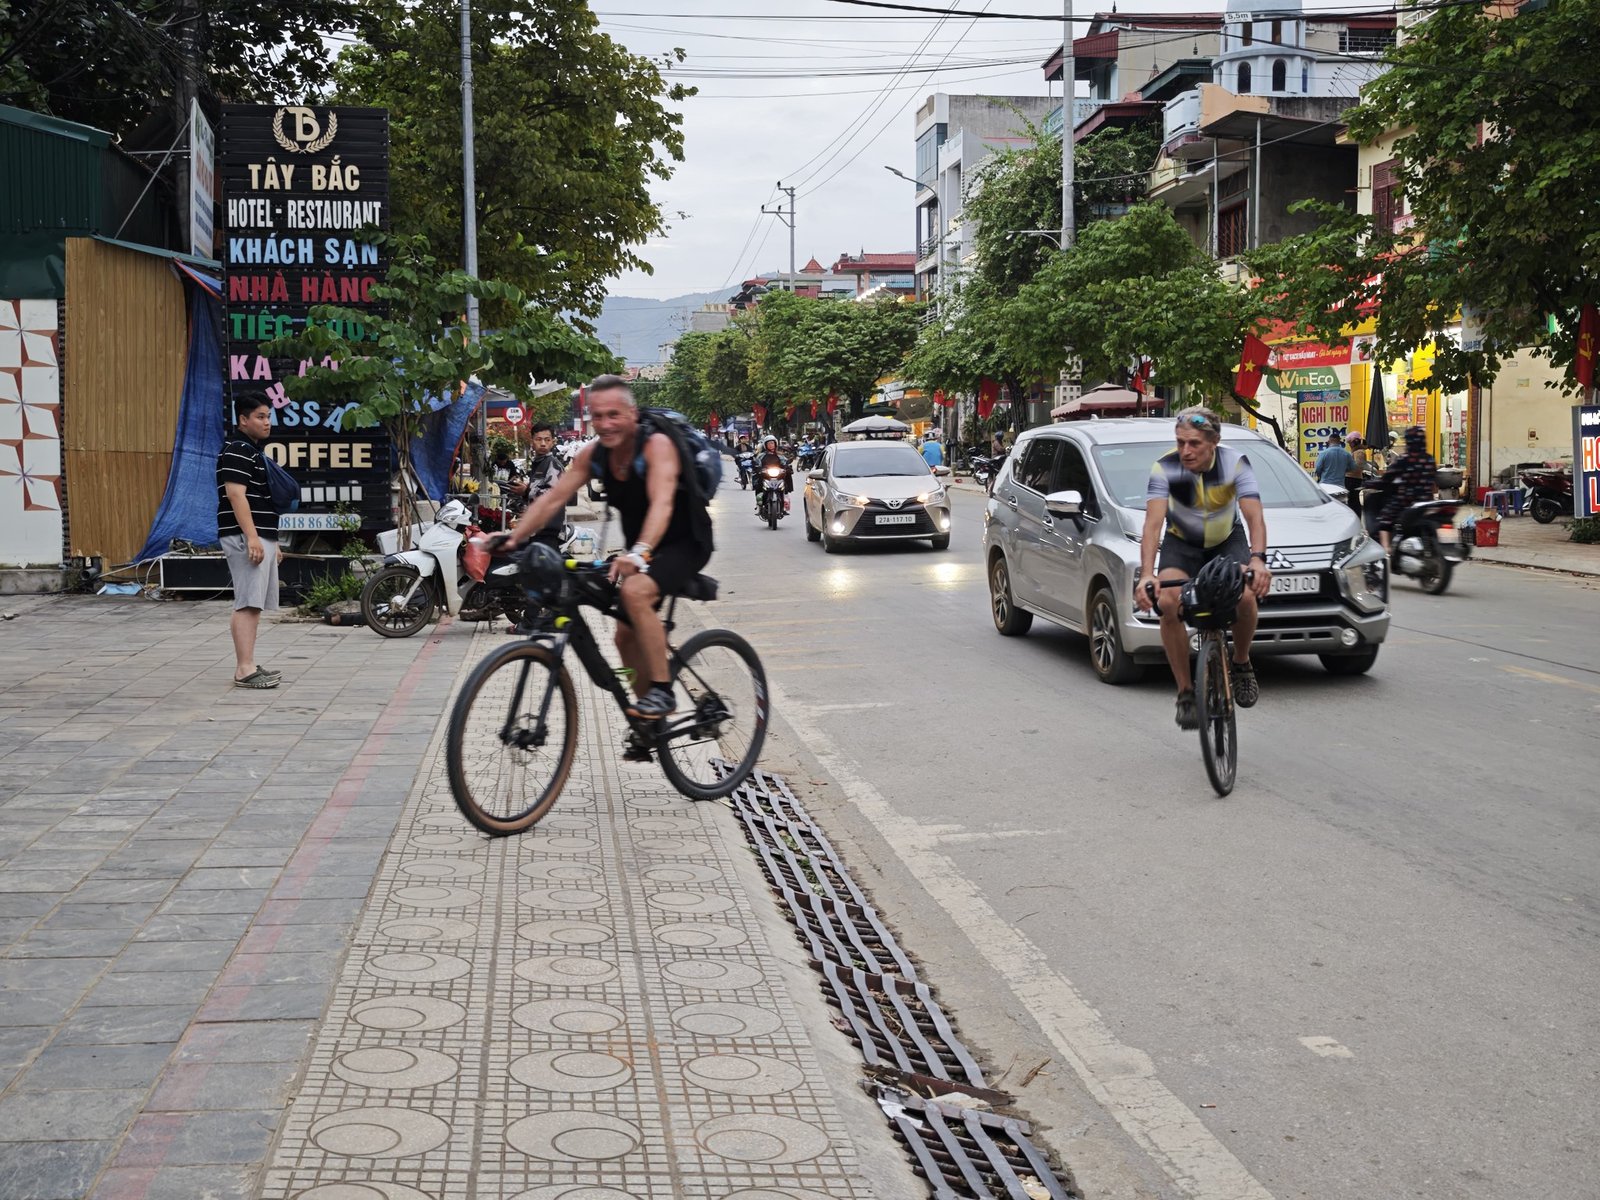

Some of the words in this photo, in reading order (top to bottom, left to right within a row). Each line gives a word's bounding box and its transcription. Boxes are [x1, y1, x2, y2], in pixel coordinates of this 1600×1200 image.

[248, 156, 295, 190] TÂY
[312, 154, 360, 191] BẮC
[228, 198, 274, 228] HOTEL
[287, 199, 382, 230] RESTAURANT
[229, 232, 314, 264] KHÁCH
[325, 237, 379, 269] SẠN
[229, 269, 289, 302] NHÀ
[1274, 370, 1334, 389] WinEco
[1301, 402, 1327, 424] NGHỈ
[264, 442, 373, 469] OFFEE
[308, 516, 322, 529] 86
